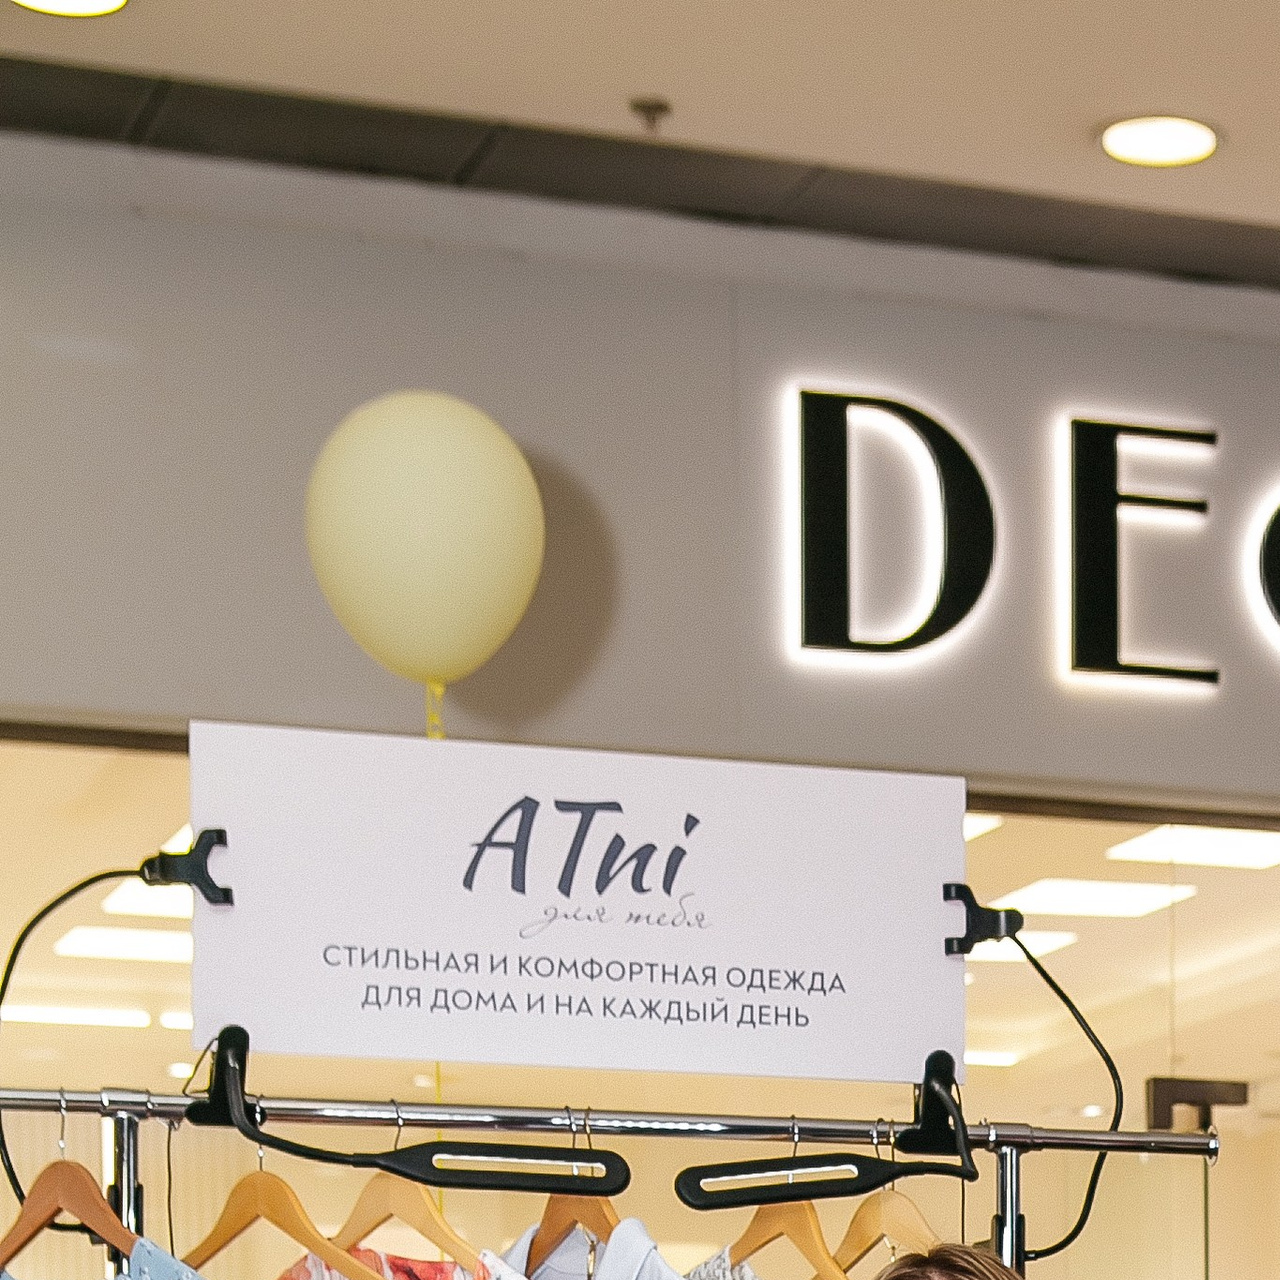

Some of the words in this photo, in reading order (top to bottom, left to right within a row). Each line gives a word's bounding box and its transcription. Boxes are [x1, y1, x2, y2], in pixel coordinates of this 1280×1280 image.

[322, 943, 480, 975] СТИЛЬНАЯ
[489, 952, 508, 977] И
[517, 955, 717, 988] КОМФОРТНАЯ
[725, 966, 847, 997] ОДЕЖДА
[360, 983, 422, 1011] ДЛЯ
[429, 987, 518, 1014] ДОМА
[526, 992, 545, 1015] И
[554, 994, 594, 1017] НА
[602, 996, 729, 1025] КАЖДЫЙ
[735, 1003, 810, 1030] ДЕНЬ
